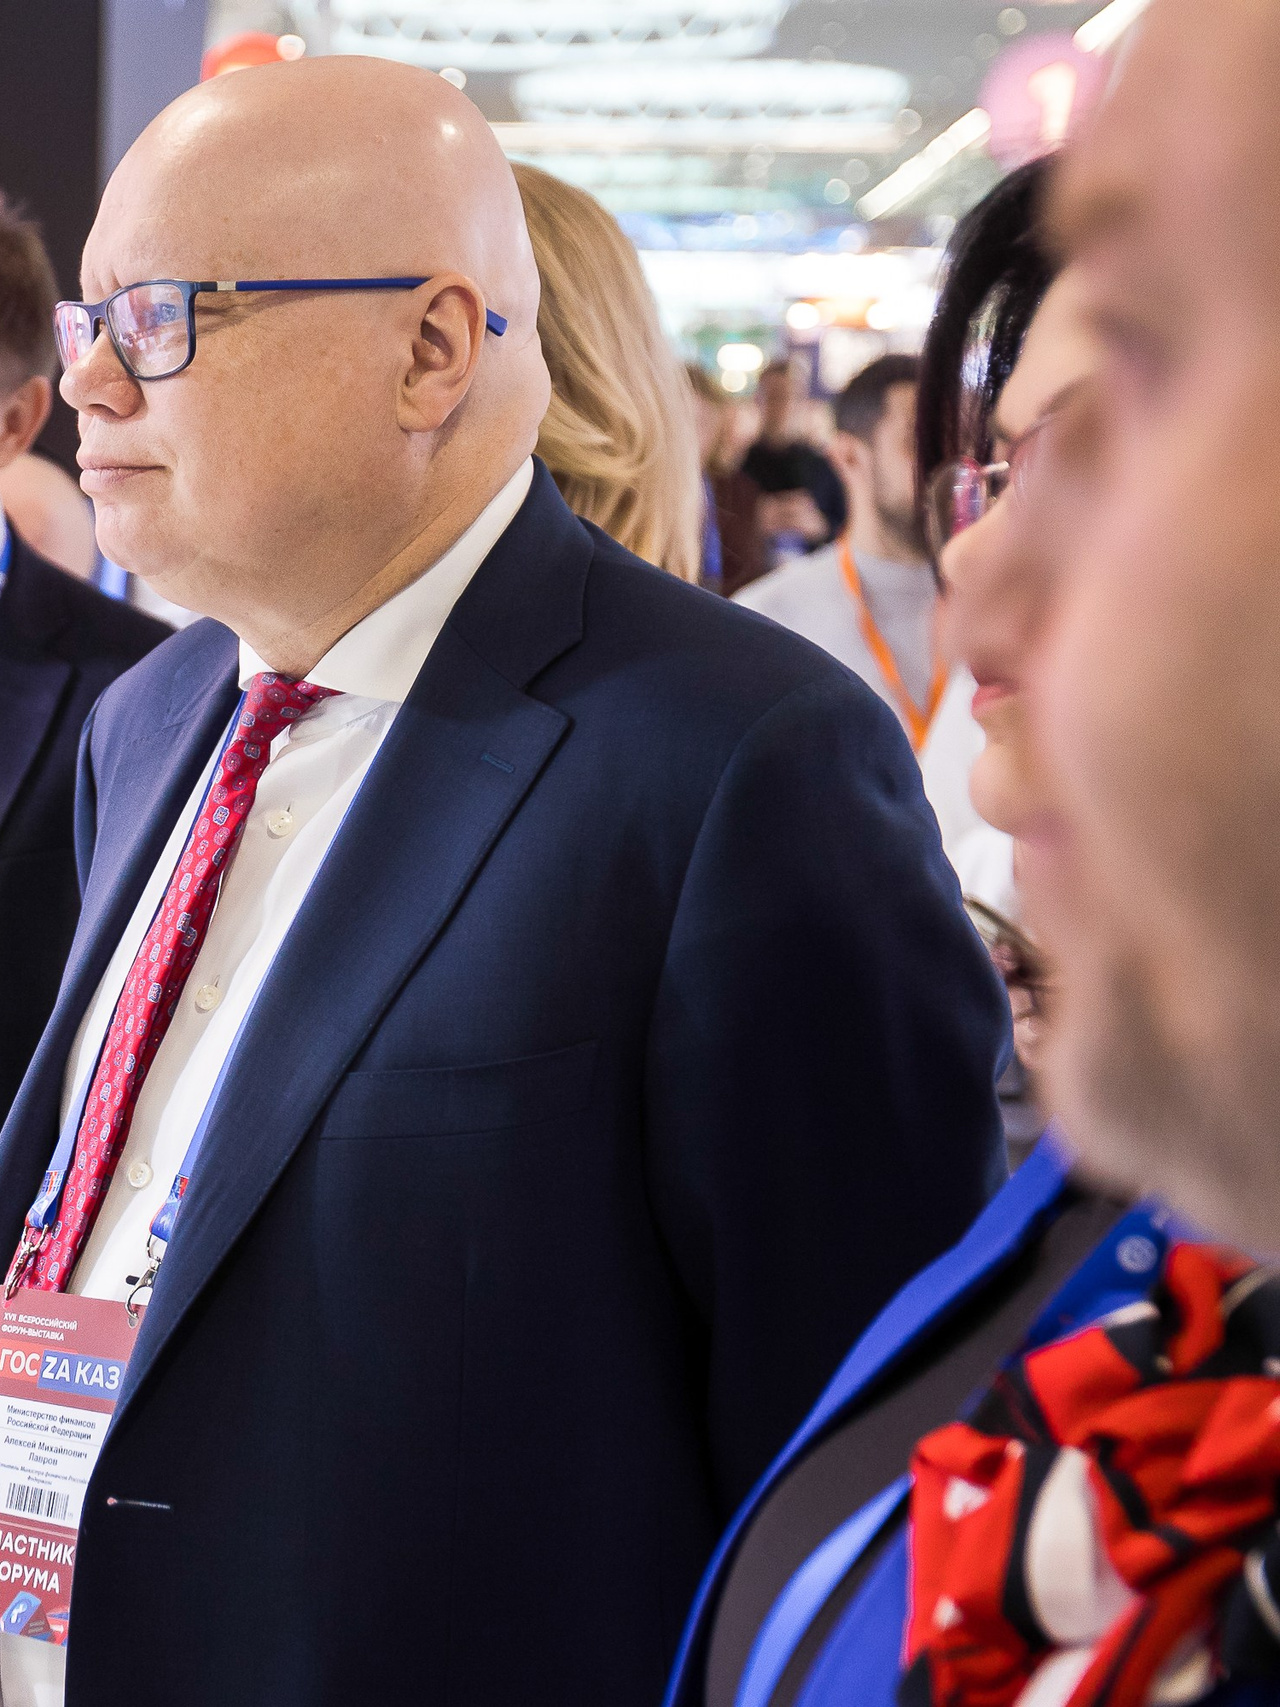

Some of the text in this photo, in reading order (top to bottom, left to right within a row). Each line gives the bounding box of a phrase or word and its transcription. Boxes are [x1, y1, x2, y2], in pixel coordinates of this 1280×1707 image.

[1, 1324, 65, 1341] ФОРУМ-ВЫСТАВКА
[18, 1314, 78, 1331] ВСЕРОССИЙСКИЙ
[6, 1404, 96, 1430] Министерство финансов
[6, 1416, 92, 1440] Российской Федерации
[4, 1435, 88, 1459] Алексей Михайлович
